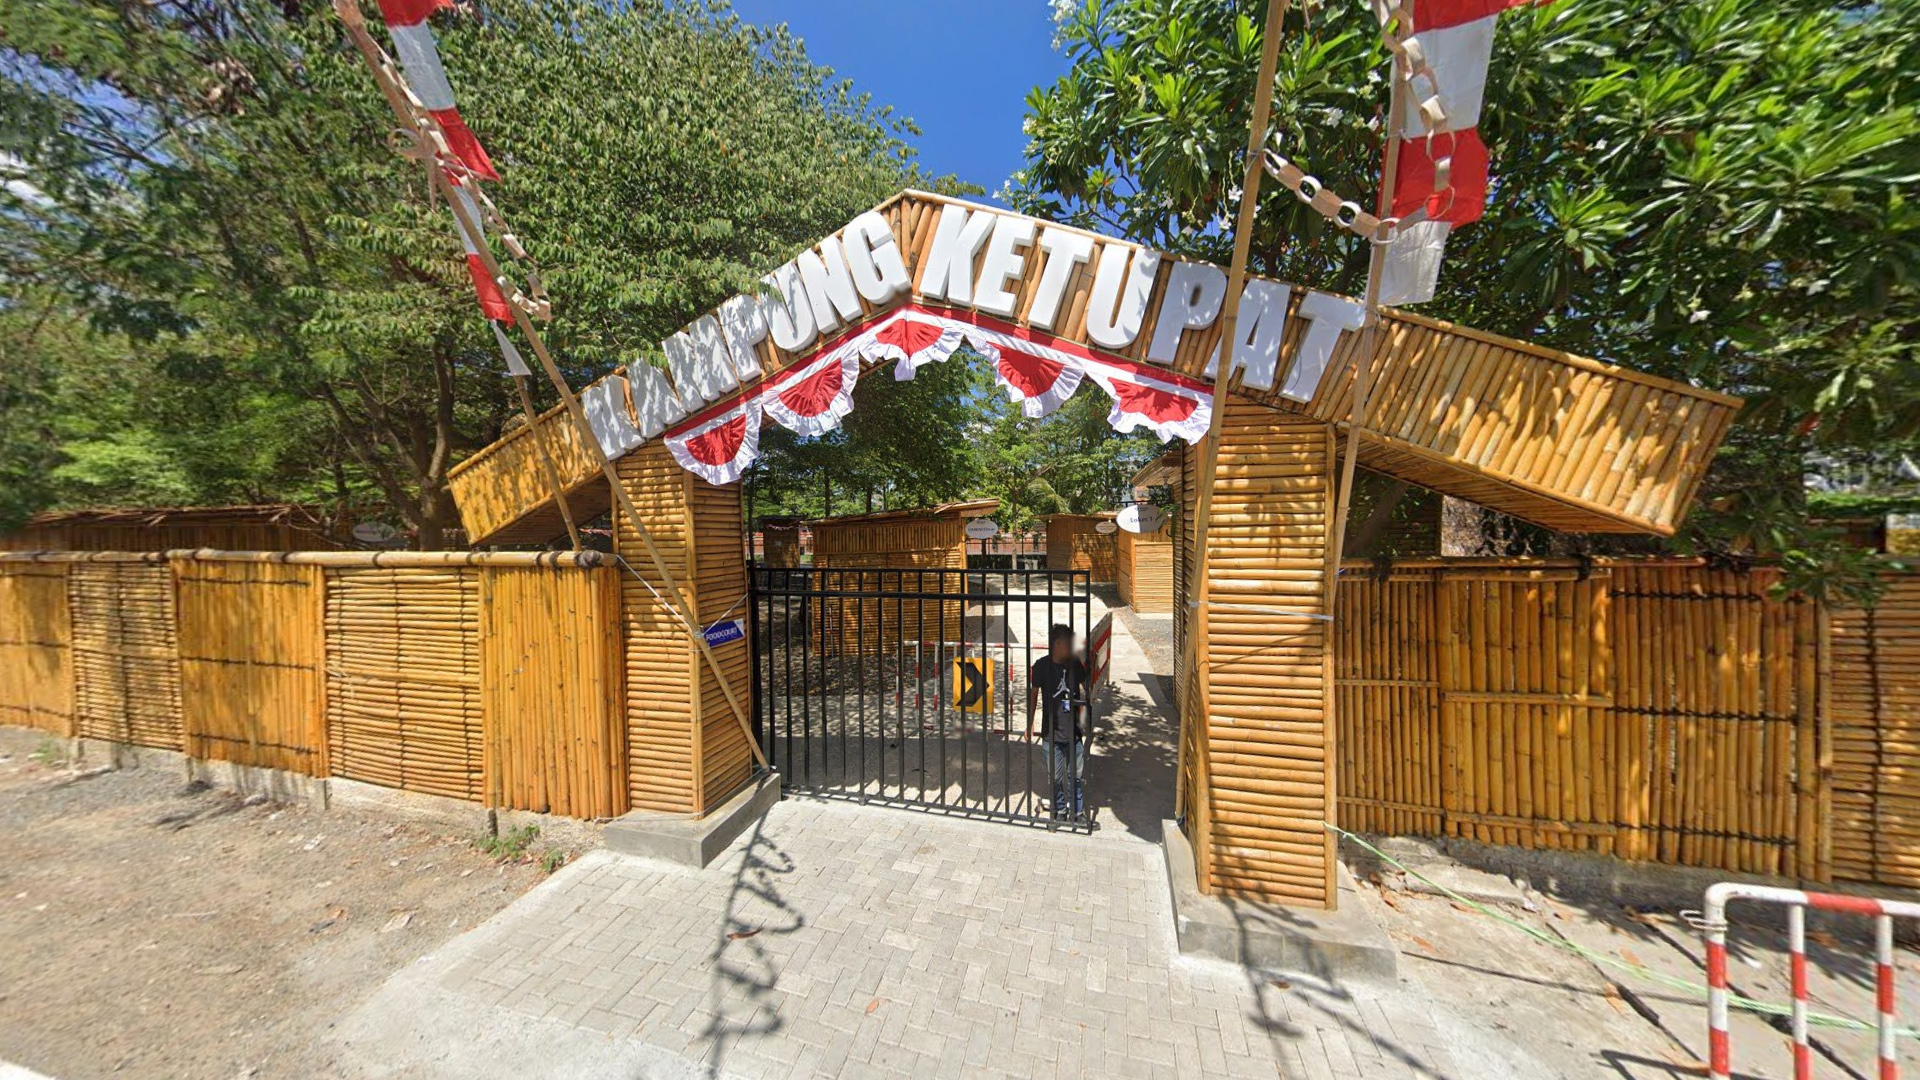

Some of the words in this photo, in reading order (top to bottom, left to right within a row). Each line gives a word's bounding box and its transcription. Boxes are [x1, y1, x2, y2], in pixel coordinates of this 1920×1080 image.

[582, 211, 911, 460] KAMPUNG
[920, 204, 1365, 403] KETUPAT
[705, 627, 737, 641] FOODCOURT
